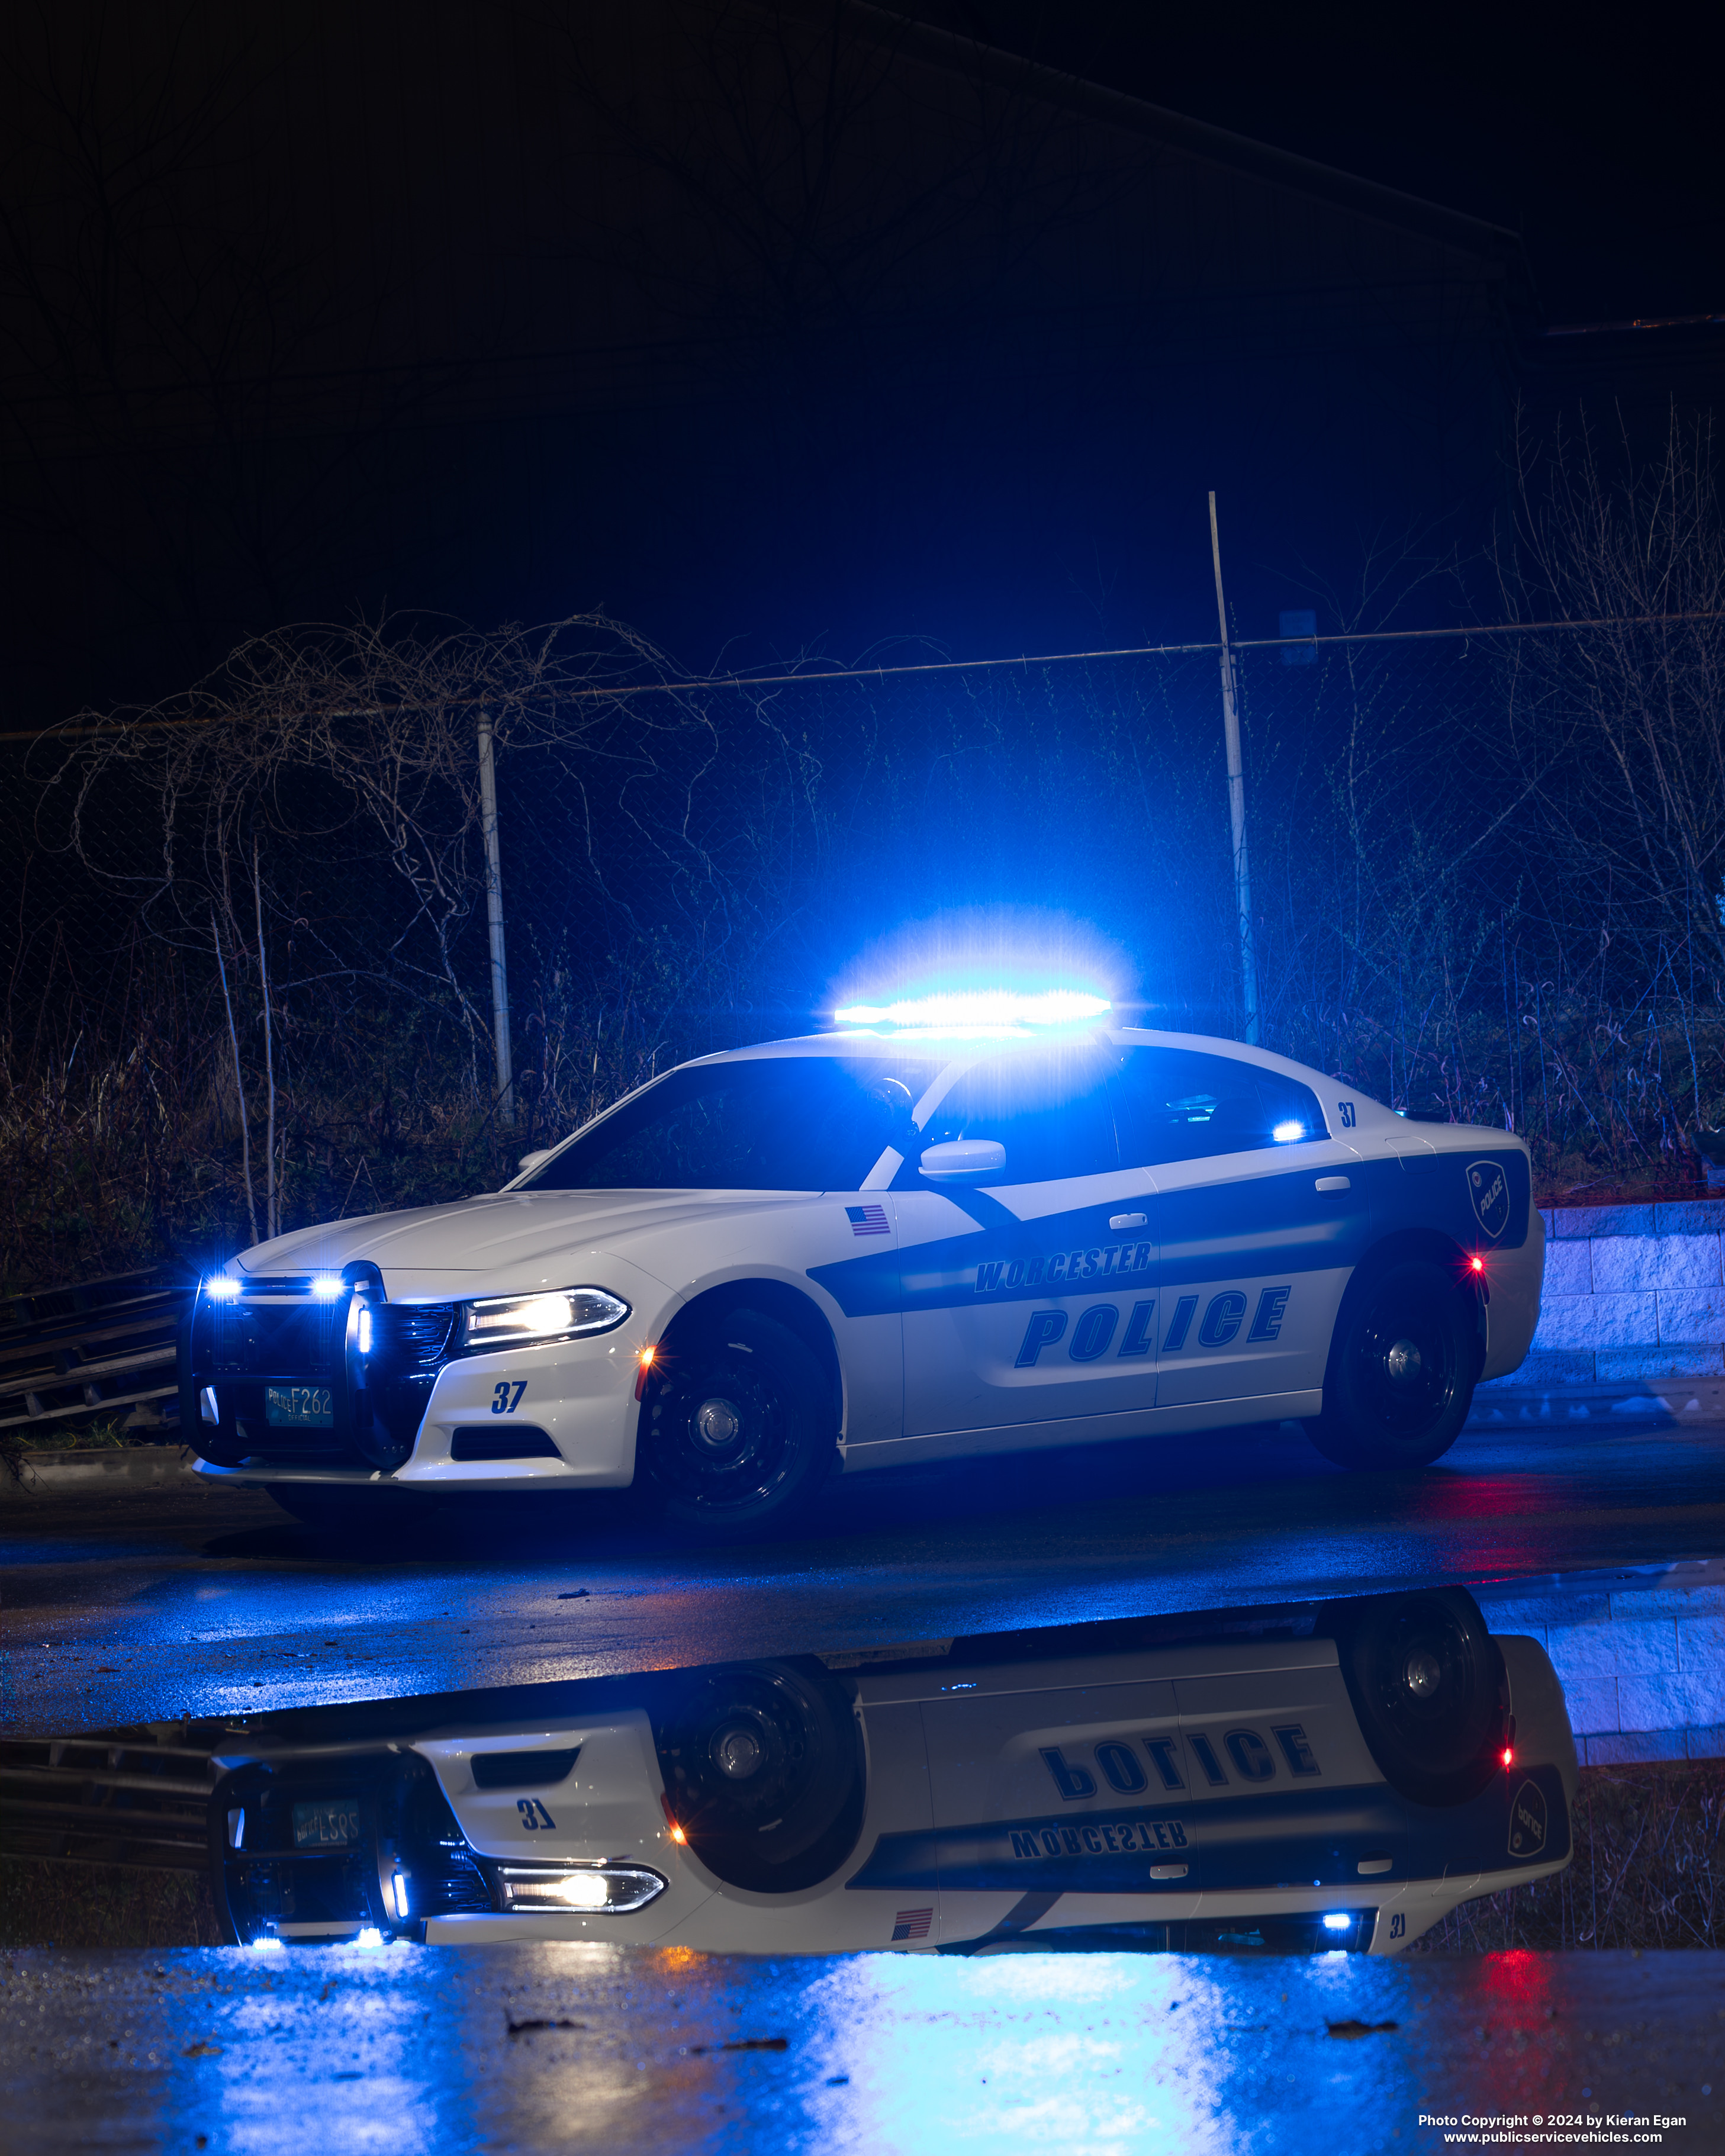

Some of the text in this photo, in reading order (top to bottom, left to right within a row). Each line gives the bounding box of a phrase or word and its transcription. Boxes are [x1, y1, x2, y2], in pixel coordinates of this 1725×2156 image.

[1338, 1102, 1356, 1128] 37
[1481, 1174, 1503, 1216] POLICE
[974, 1242, 1152, 1293] WORCESTER
[1013, 1285, 1292, 1369] POLICE
[268, 1388, 331, 1414] POLICE F262
[491, 1380, 528, 1414] 37
